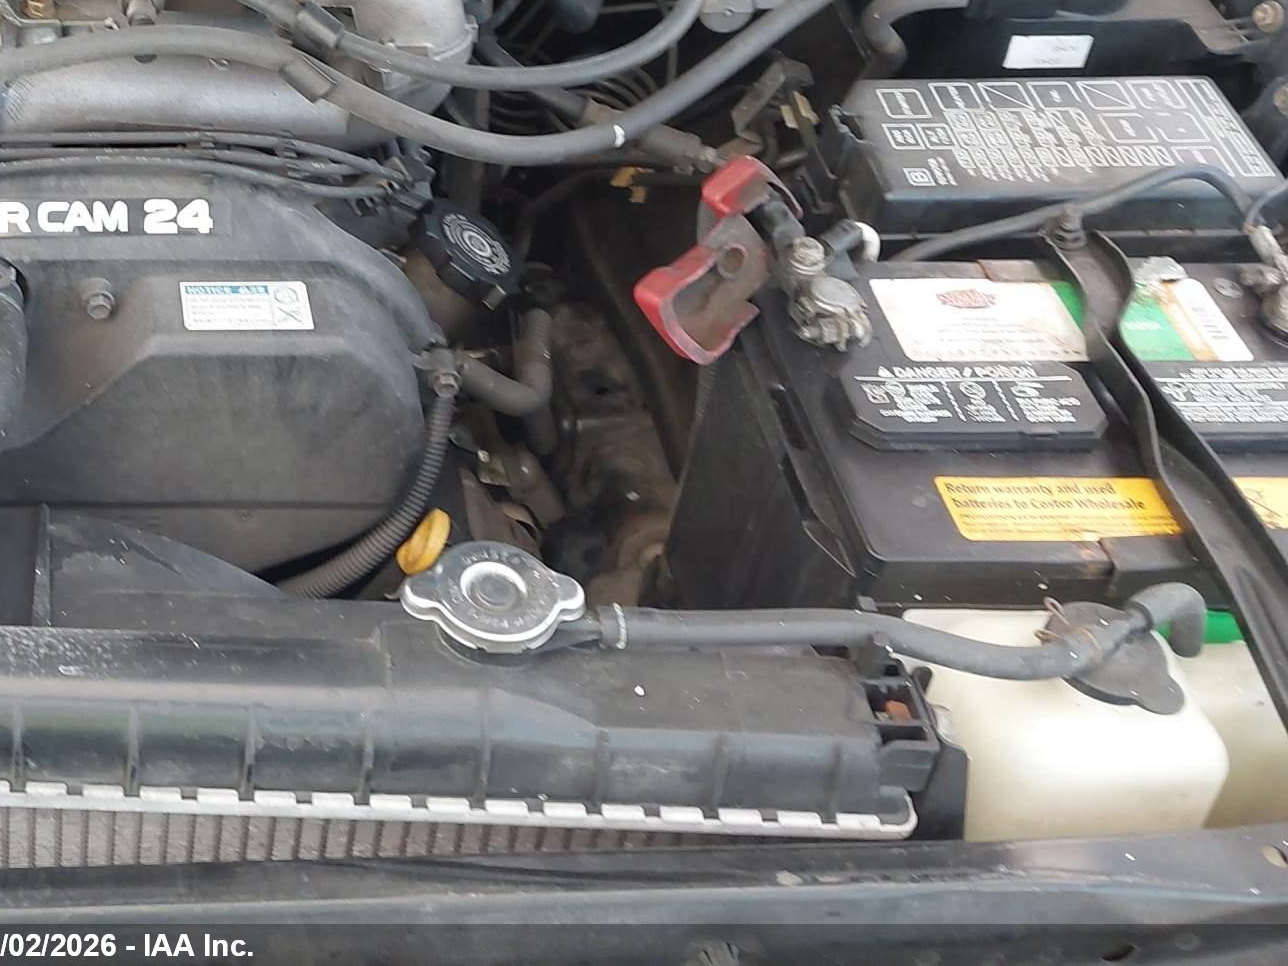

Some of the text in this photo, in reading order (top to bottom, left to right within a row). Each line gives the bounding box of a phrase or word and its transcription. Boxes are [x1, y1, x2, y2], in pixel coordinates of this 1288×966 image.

[37, 201, 130, 234] CAM
[143, 199, 213, 235] 24
[893, 366, 962, 379] DANGER
[973, 365, 1037, 379] POISON
[944, 483, 1117, 496] Return warranty and used
[953, 498, 1013, 509] batteries
[1075, 498, 1146, 510] Wholesale
